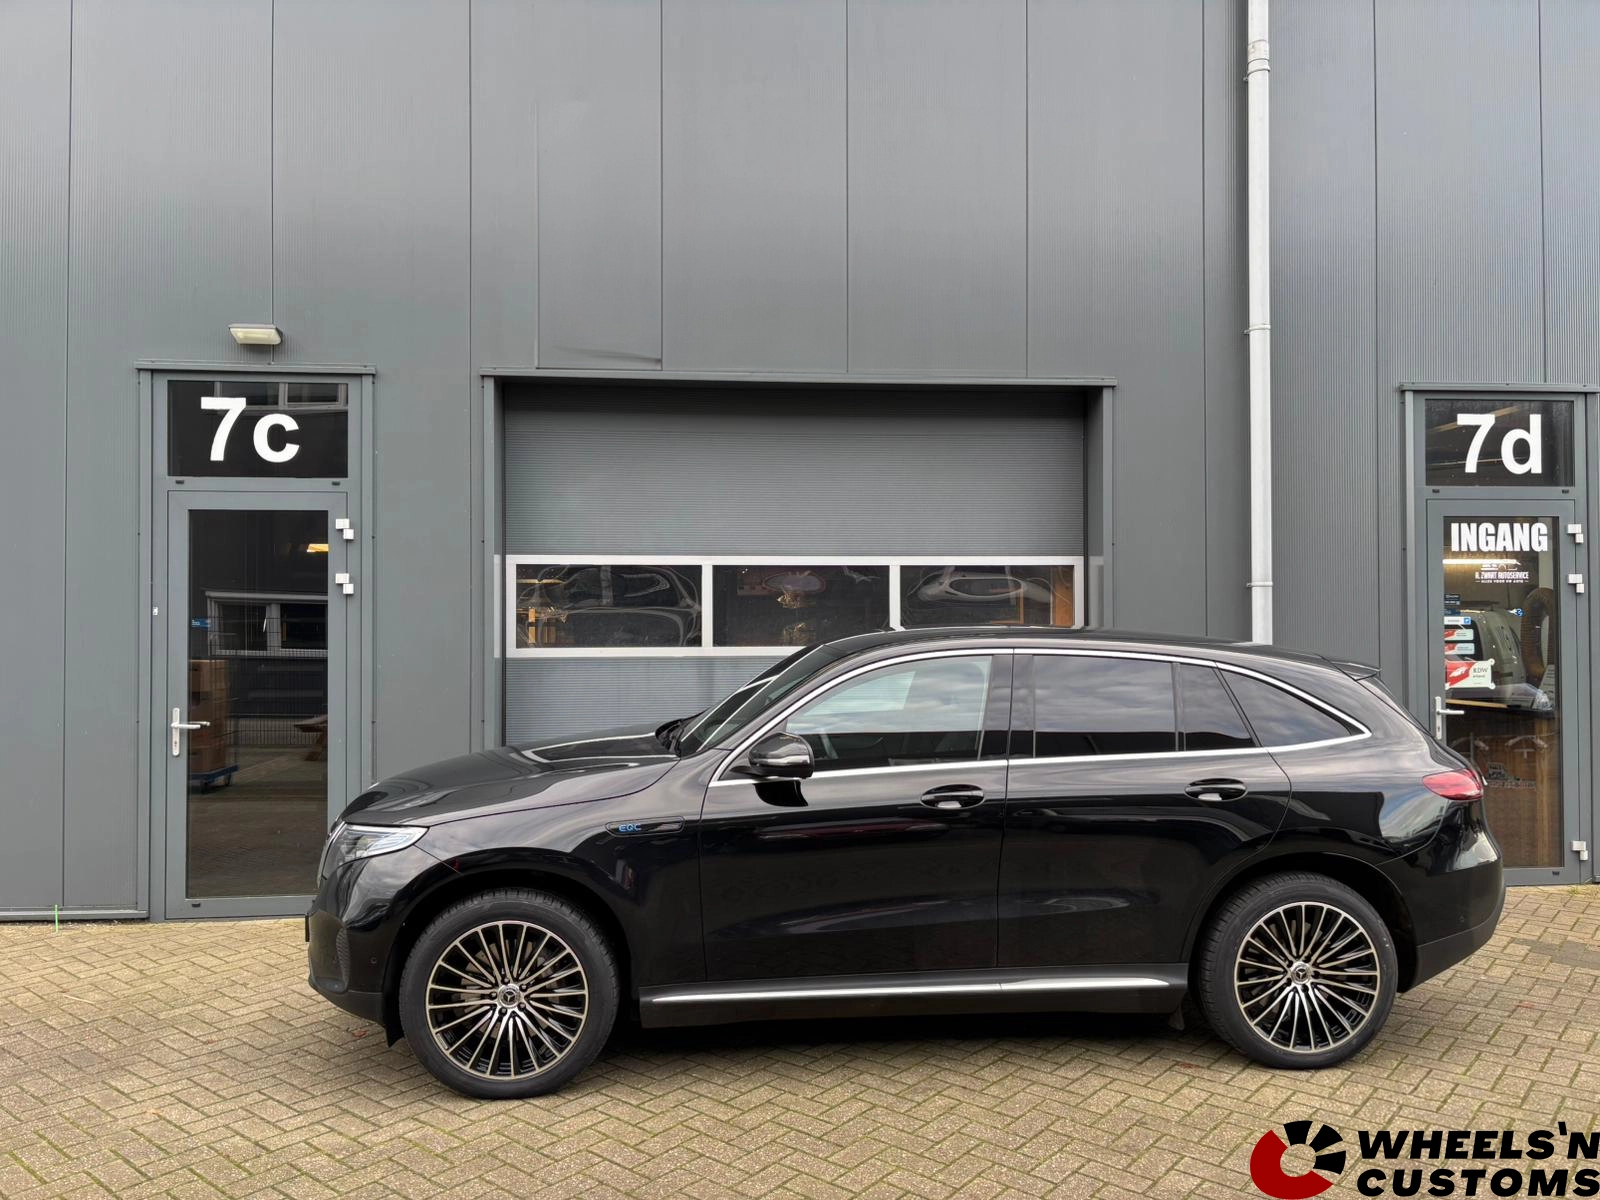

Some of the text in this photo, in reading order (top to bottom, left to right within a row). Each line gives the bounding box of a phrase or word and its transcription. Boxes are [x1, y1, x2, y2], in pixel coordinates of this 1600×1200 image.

[200, 396, 300, 463] 7c
[1456, 413, 1543, 475] 7d
[1450, 522, 1549, 552] INGANG
[618, 823, 641, 832] EQC
